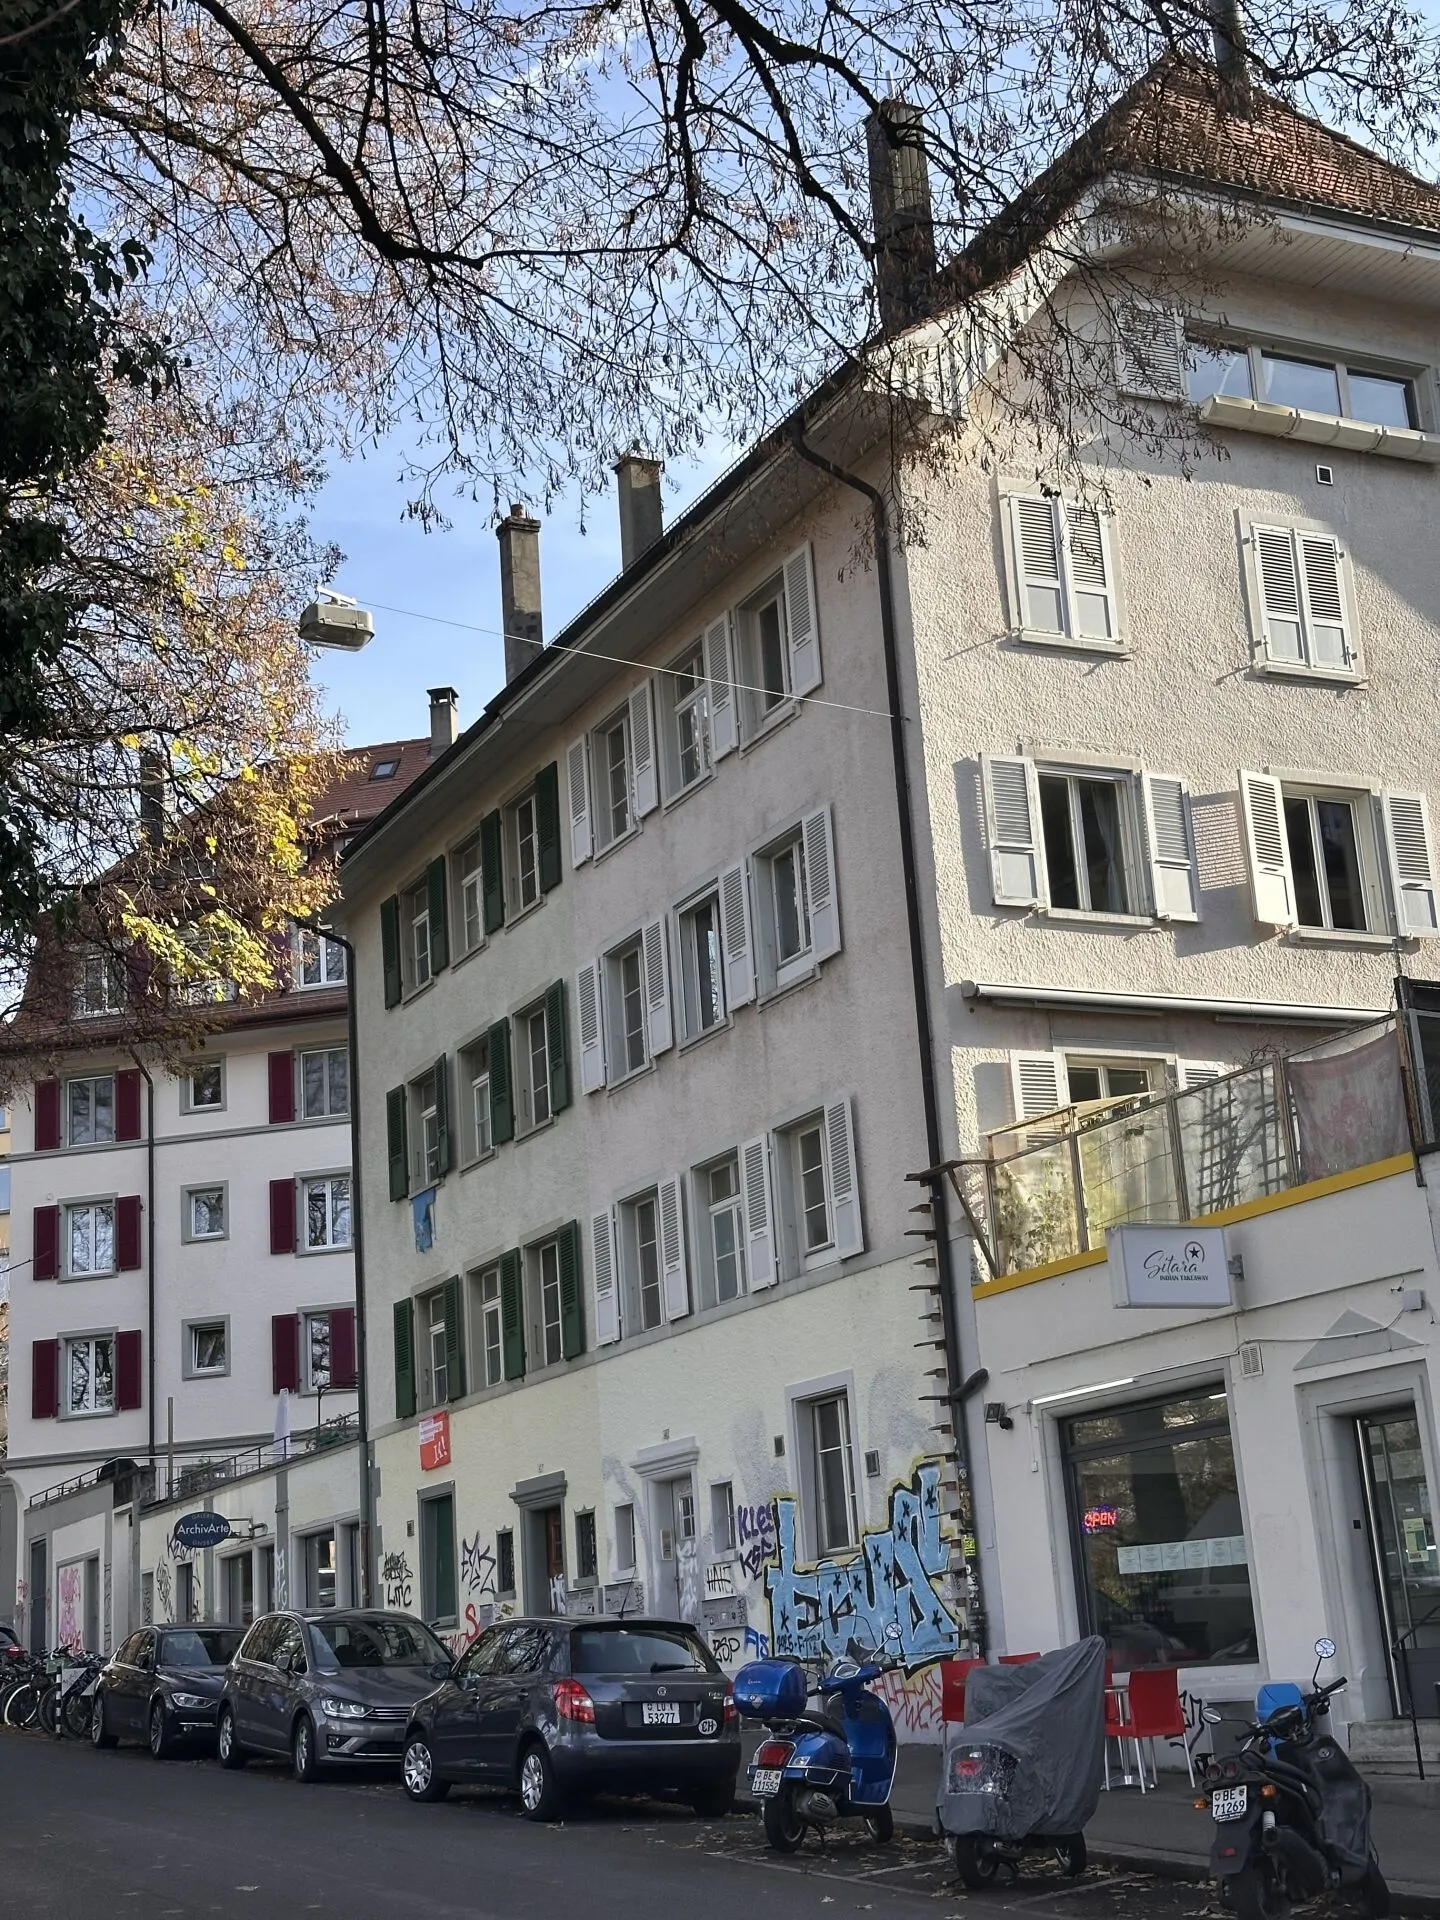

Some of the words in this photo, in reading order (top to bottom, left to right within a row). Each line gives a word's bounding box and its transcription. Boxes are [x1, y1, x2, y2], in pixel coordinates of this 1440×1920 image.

[1144, 1250, 1198, 1279] Sitara
[1084, 1511, 1117, 1528] OPEN
[177, 1523, 230, 1535] ArchivArte
[656, 1702, 666, 1711] LU
[647, 1712, 675, 1724] 53277
[701, 1720, 714, 1732] CH
[763, 1771, 774, 1780] BE
[753, 1781, 779, 1792] 111552
[1223, 1789, 1236, 1801] BE
[1214, 1799, 1245, 1816] 71269
